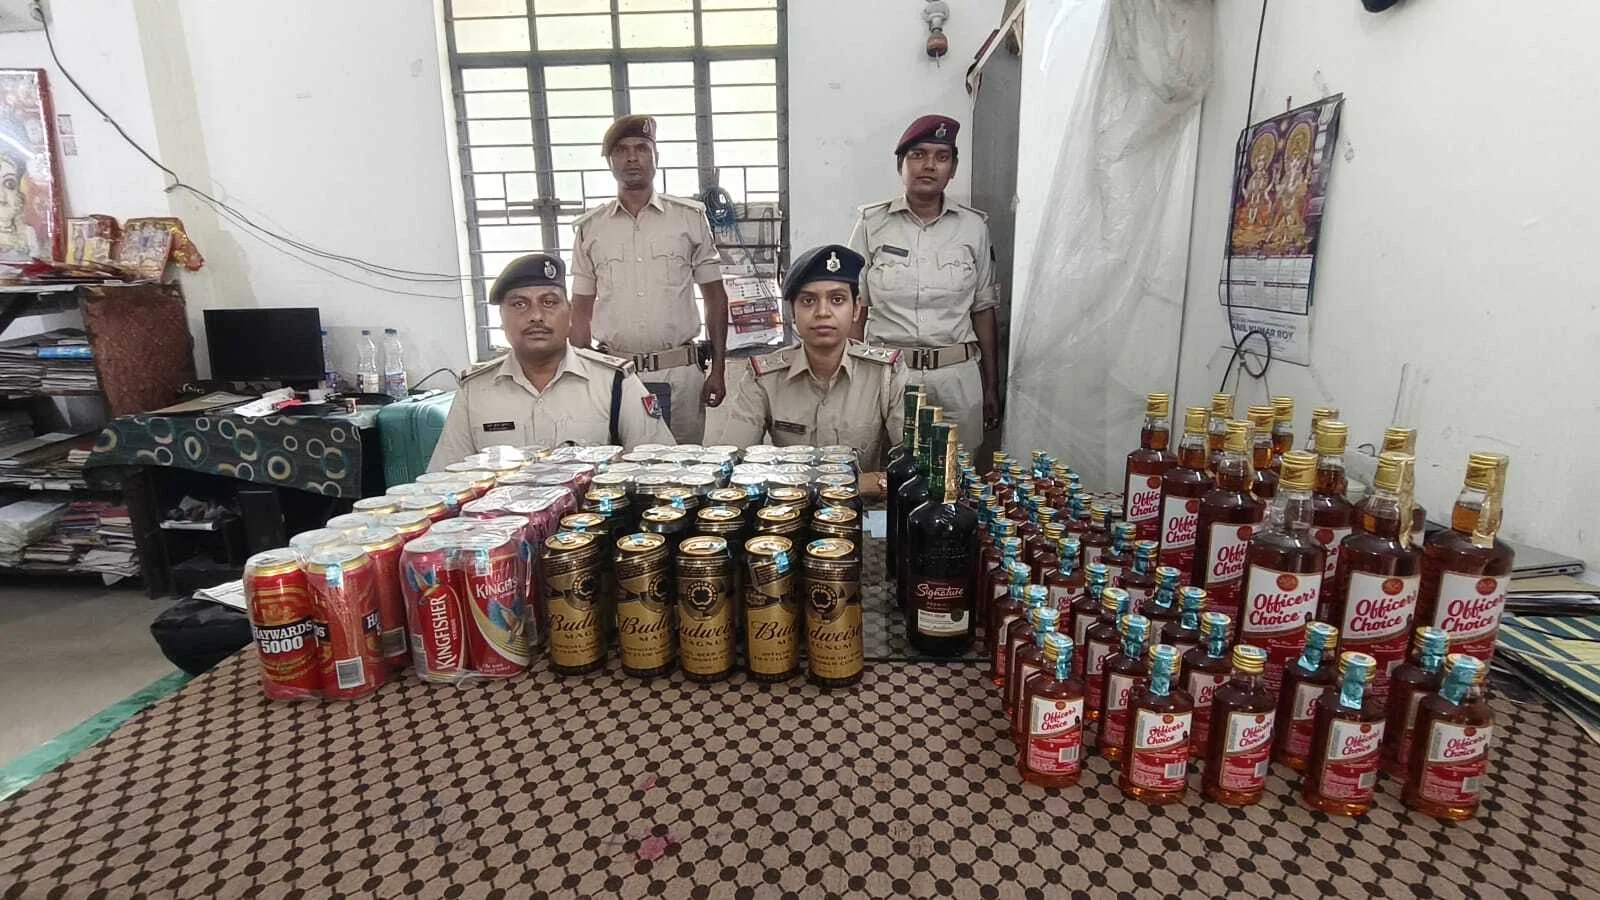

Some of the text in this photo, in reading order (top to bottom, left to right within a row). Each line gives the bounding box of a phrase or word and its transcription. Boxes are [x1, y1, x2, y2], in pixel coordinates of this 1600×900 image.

[1276, 330, 1294, 340] ROY
[918, 583, 964, 600] Signature
[1254, 588, 1316, 613] Officer's
[1249, 611, 1300, 625] Choice
[1350, 614, 1404, 632] Choice
[1441, 615, 1494, 632] Choice
[252, 620, 313, 640] HAYWARDS
[429, 593, 457, 670] KINGFISHER
[261, 635, 304, 654] 5000
[1041, 720, 1068, 731] Choice
[1146, 735, 1175, 746] Choice
